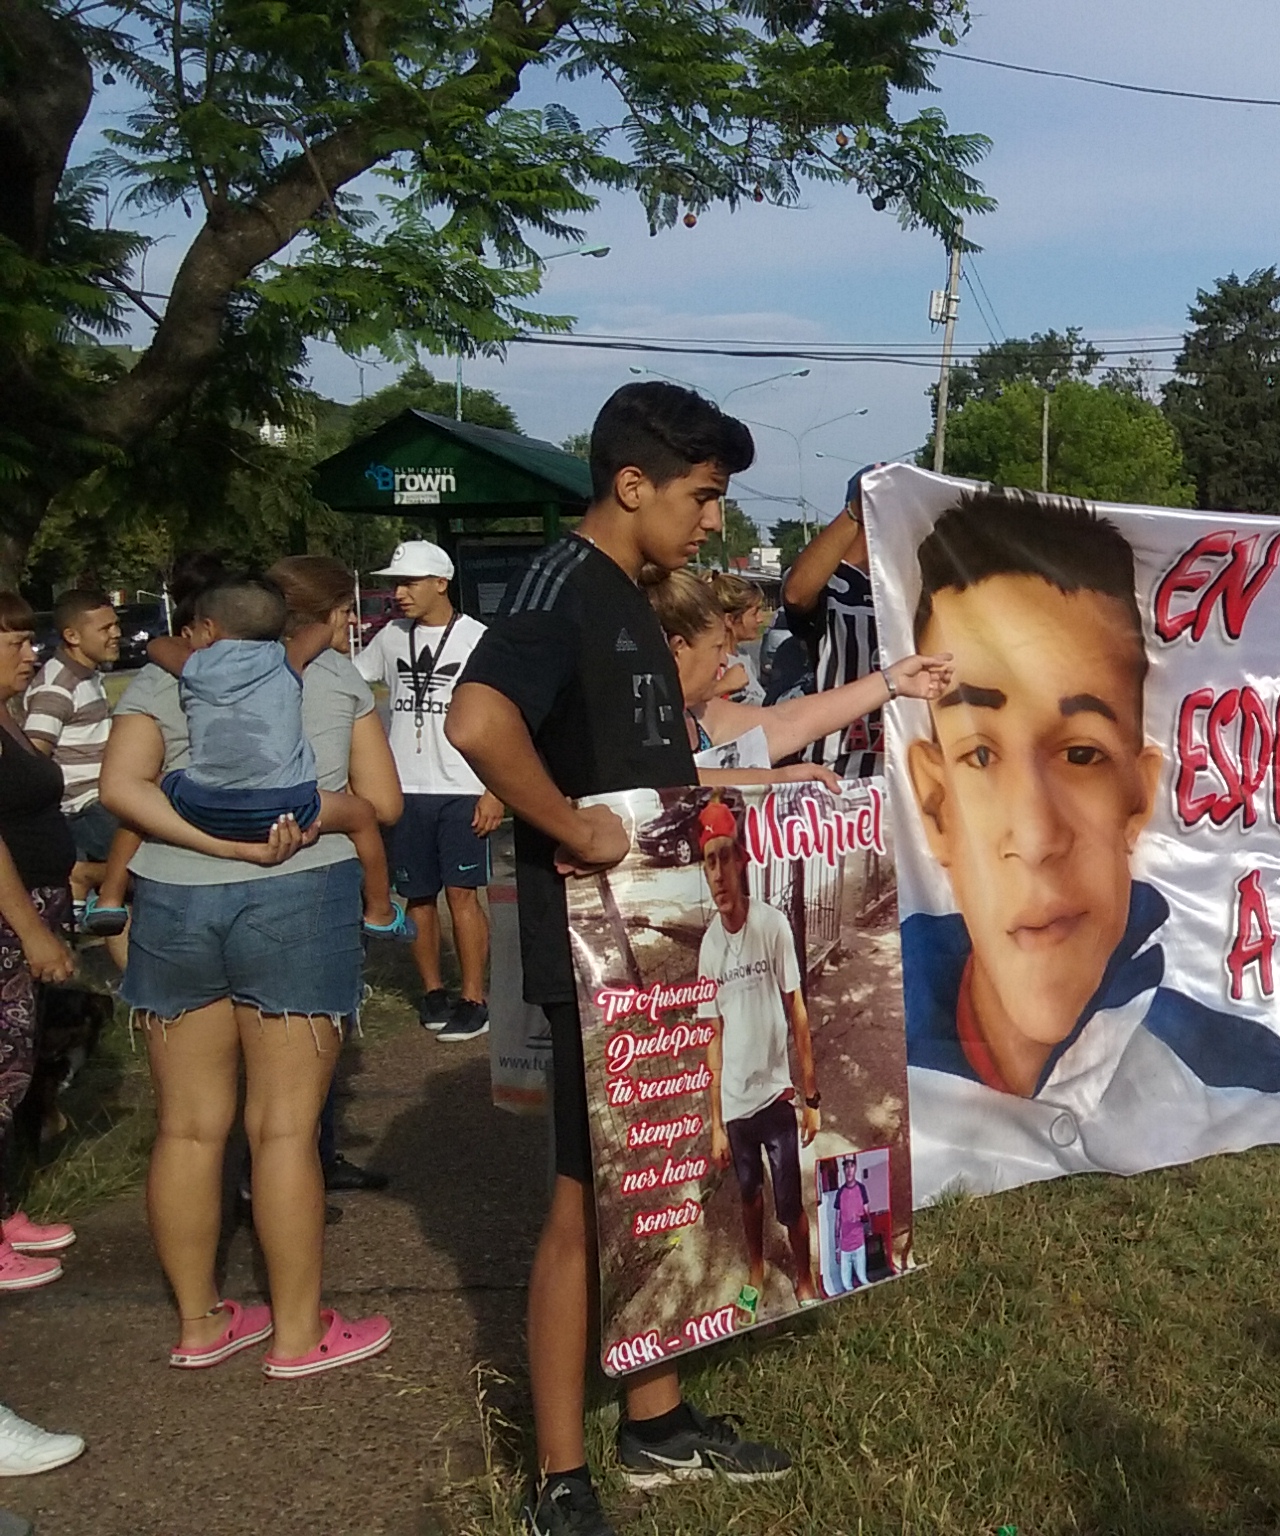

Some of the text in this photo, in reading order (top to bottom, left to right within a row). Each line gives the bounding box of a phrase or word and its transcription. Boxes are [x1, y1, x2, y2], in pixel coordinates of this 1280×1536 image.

[377, 466, 456, 492] Brown
[394, 466, 455, 475] ALMIRANTE
[395, 695, 450, 714] addas
[746, 787, 885, 867] Nahuel
[1227, 870, 1275, 1000] A
[597, 988, 635, 1022] Tu
[635, 978, 715, 1021] Ausencia
[608, 1063, 712, 1104] tu recuerdo
[629, 1116, 702, 1148] siempre
[623, 1157, 707, 1192] nos hara
[635, 1201, 699, 1234] sonreir
